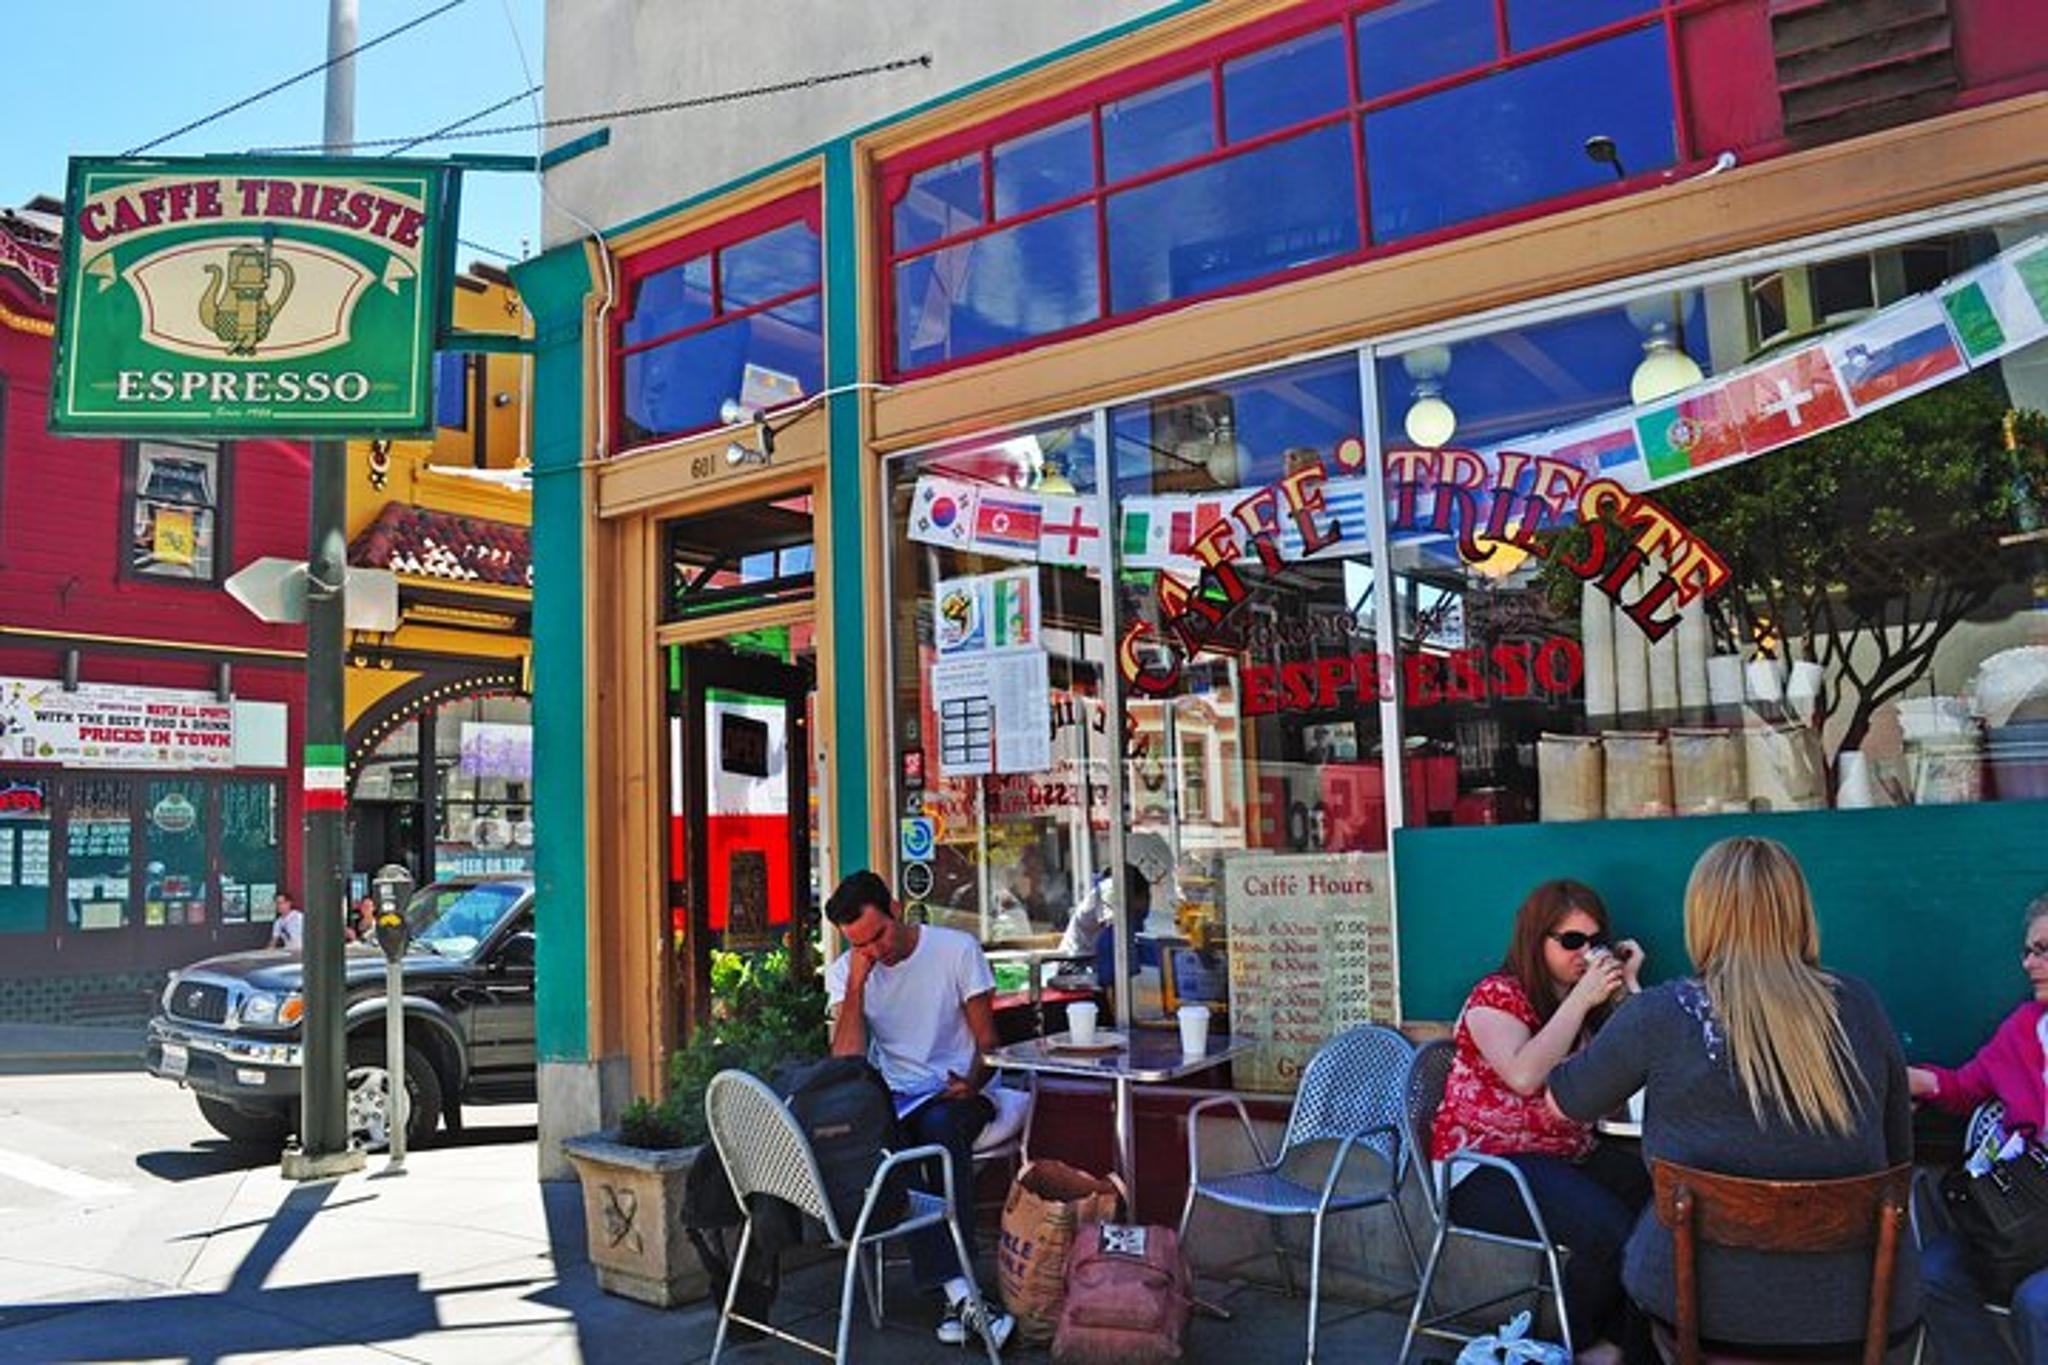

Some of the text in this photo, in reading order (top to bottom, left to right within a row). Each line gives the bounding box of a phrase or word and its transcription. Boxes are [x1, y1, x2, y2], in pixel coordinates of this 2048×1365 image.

[78, 179, 427, 248] CAFFE TRIESTE
[116, 371, 370, 401] ESPRESSO
[690, 454, 716, 478] 601
[1385, 448, 1730, 643] TRIESTE
[1240, 635, 1583, 716] ESPRESSO
[35, 710, 230, 732] WITH THE BEST FOOD & DRINK
[79, 727, 230, 748] PRICES IN TOWN
[1308, 875, 1374, 895] Hours
